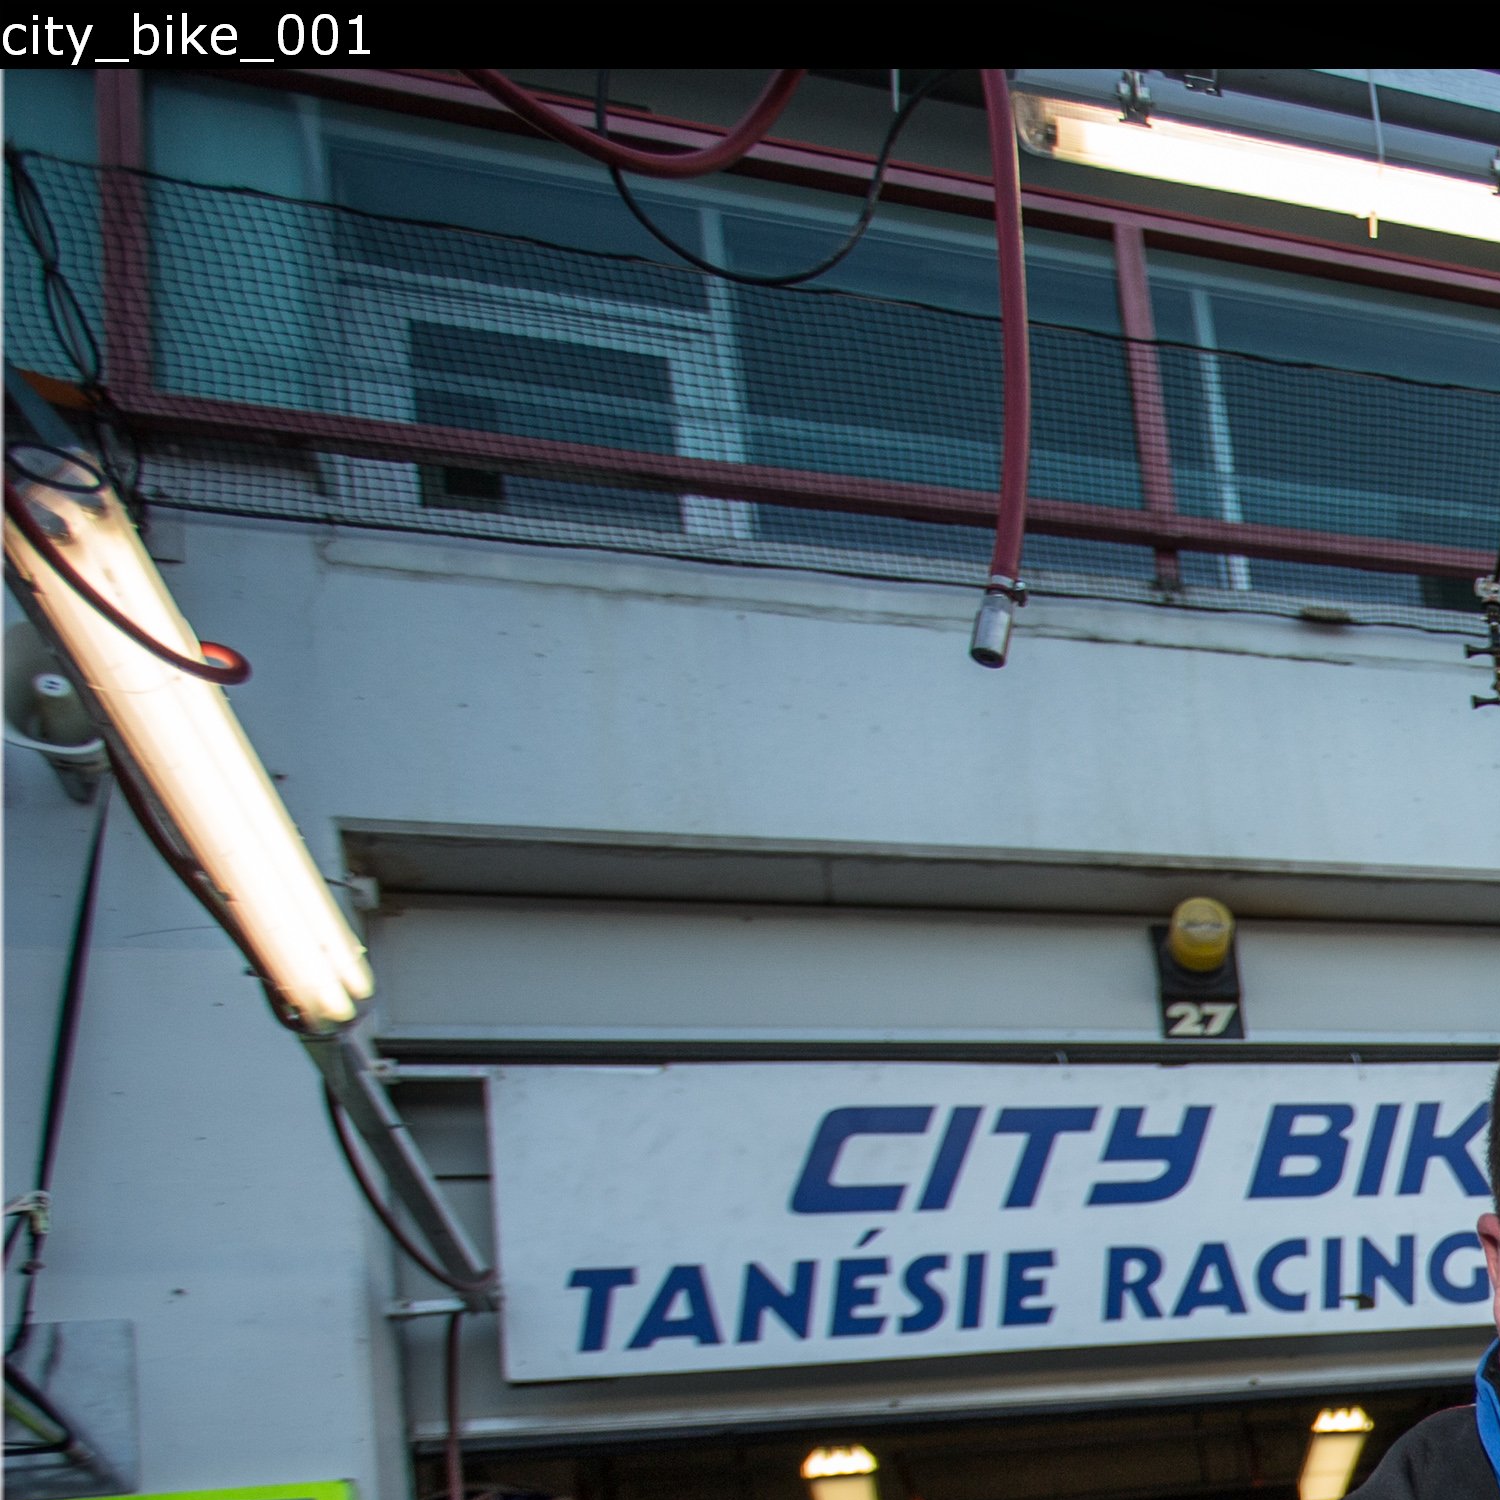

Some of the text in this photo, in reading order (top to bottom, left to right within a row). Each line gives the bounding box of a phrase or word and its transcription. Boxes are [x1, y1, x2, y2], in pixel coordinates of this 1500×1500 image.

[1167, 1003, 1237, 1037] 27
[788, 1101, 1494, 1213] CITY BIK
[568, 1230, 1495, 1352] TANÉSIE RACING
